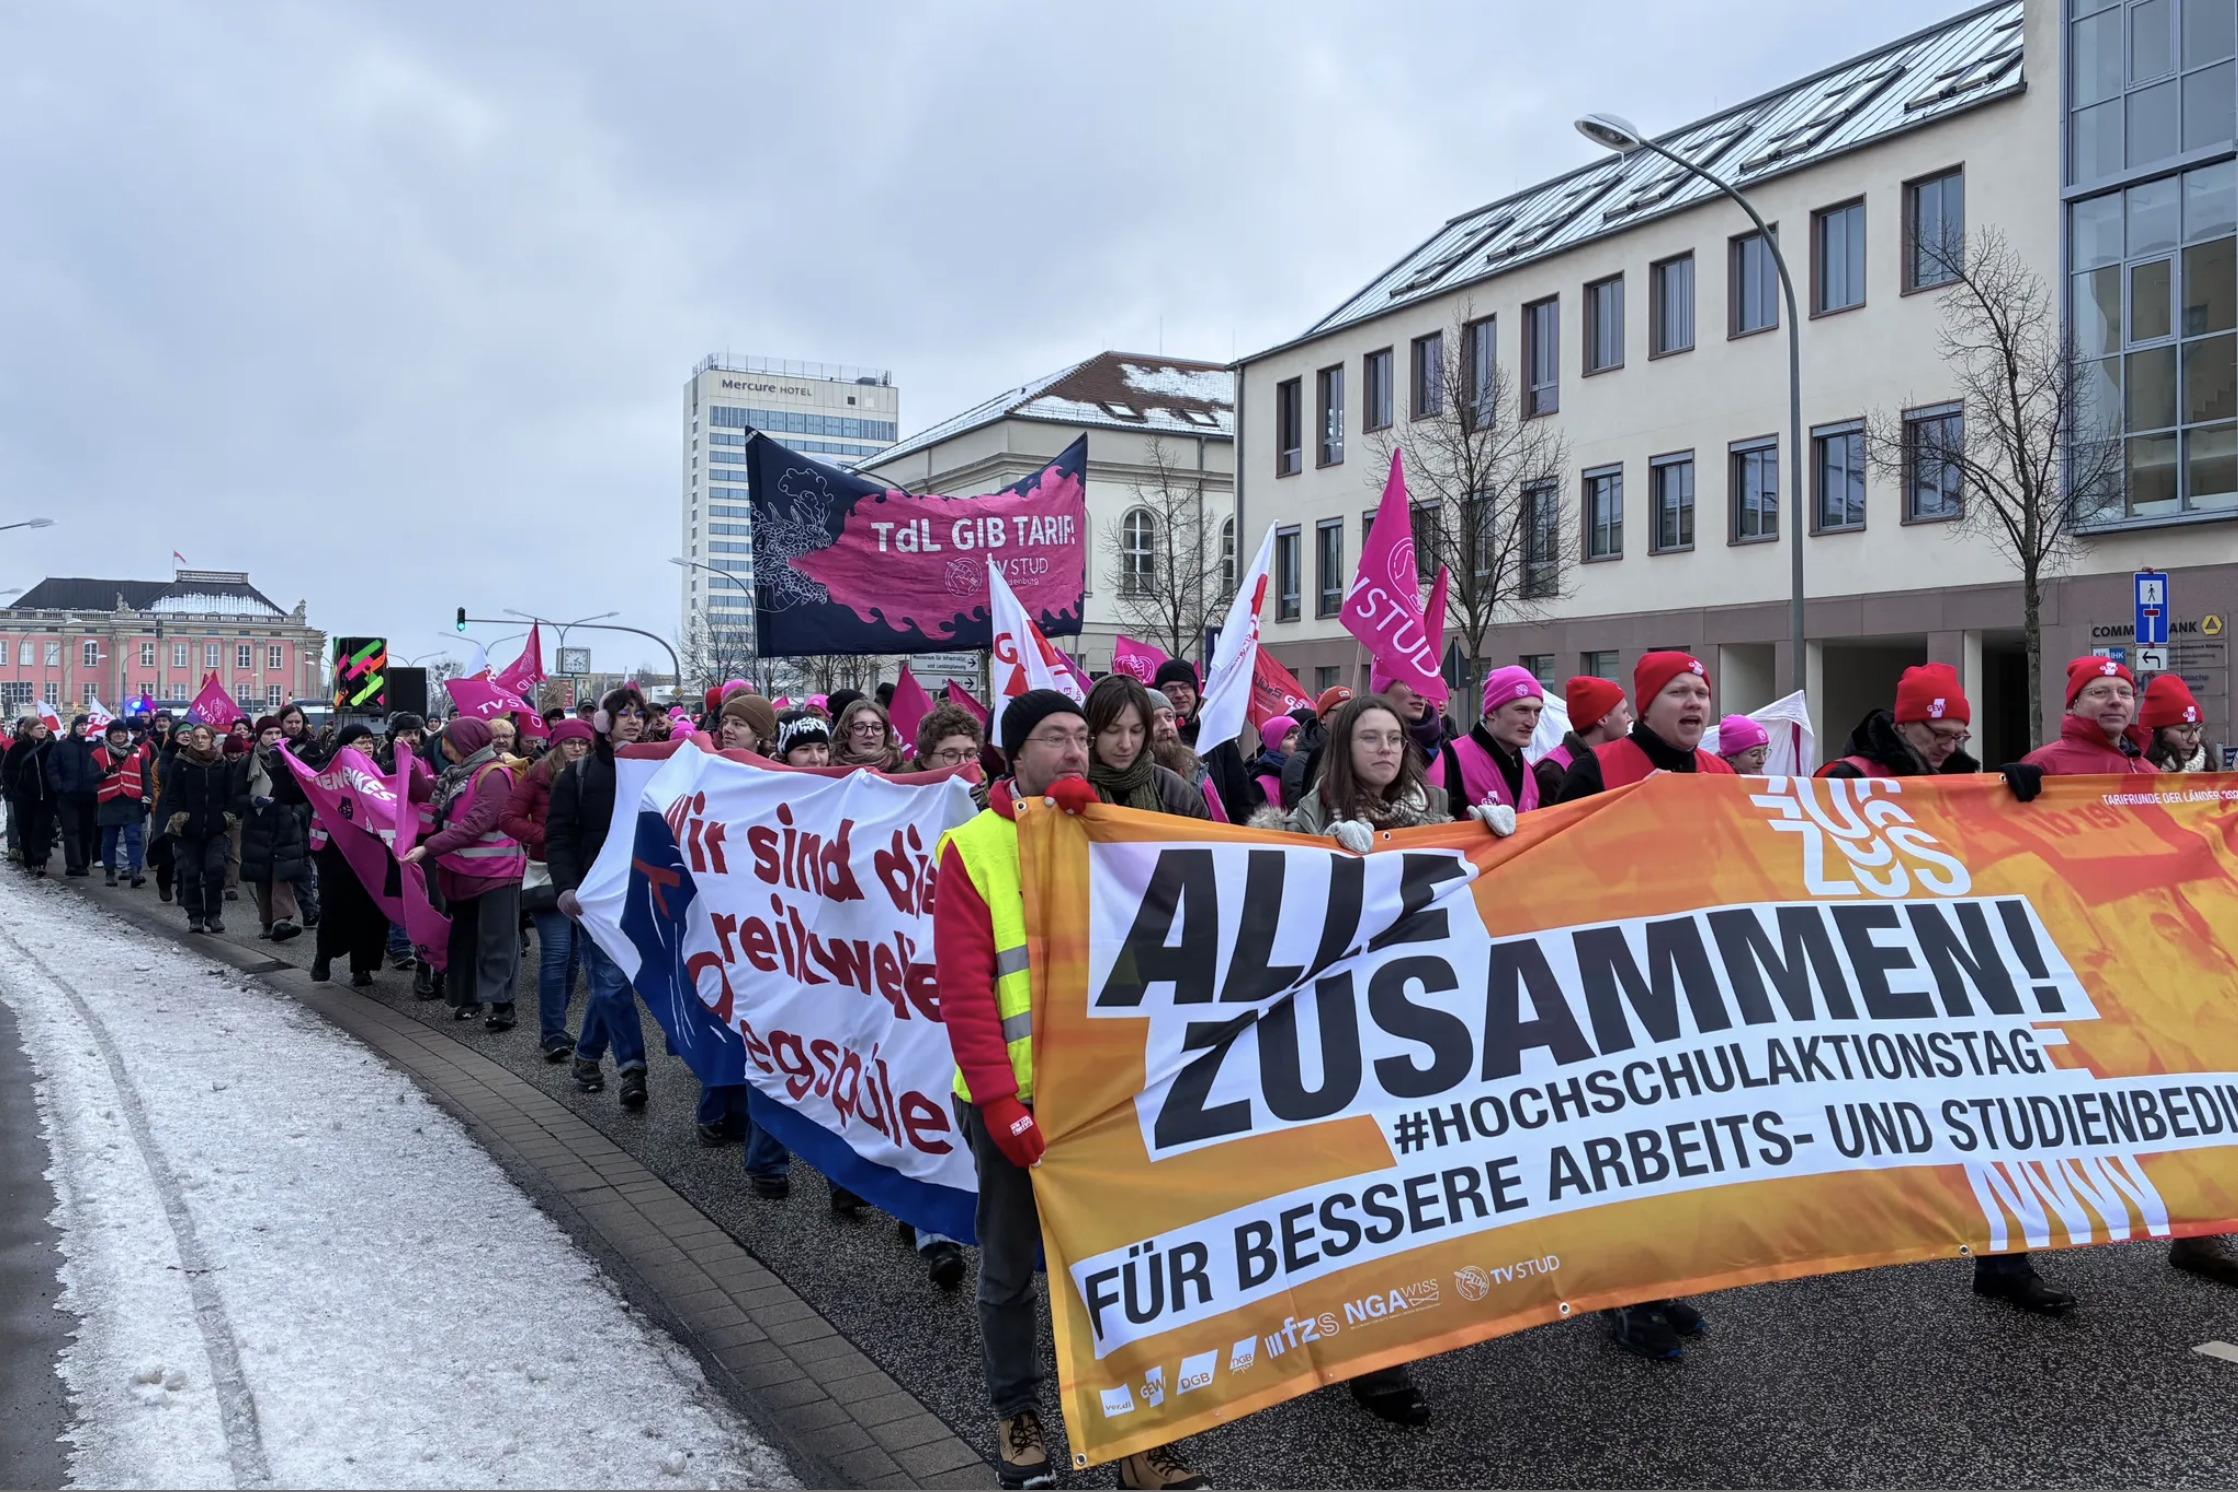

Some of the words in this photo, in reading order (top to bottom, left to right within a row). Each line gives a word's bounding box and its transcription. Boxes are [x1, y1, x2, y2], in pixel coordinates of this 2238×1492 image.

[722, 379, 776, 393] Mercure
[780, 386, 812, 396] HOTEL
[871, 518, 942, 553] TdL
[952, 516, 1006, 550] GIB
[1010, 557, 1049, 576] STUD
[1356, 588, 1440, 678] STUD
[2092, 621, 2198, 638] COMMANK
[2110, 651, 2124, 659] IHK
[477, 699, 503, 715] TV
[2102, 793, 2162, 806] TARIFRUNDE
[2162, 792, 2183, 804] DER
[2183, 789, 2220, 802] LÄNDER
[747, 802, 865, 902] sind
[1095, 848, 1467, 1007] ALLE
[1154, 900, 2067, 1150] ZUSAMMEN!
[1393, 1028, 2045, 1155] #HOCHSCHULAKTIONSTAG
[1084, 1239, 1214, 1342] FÜR
[1234, 1156, 1529, 1291] BESSERE
[1547, 1111, 1814, 1202] ARBEITS-
[1826, 1101, 1934, 1158] UND
[1140, 1376, 1167, 1399] GEW
[1181, 1372, 1211, 1390] DGB
[1231, 1353, 1253, 1368] DGB
[1281, 1312, 1340, 1349] fzs
[1490, 1265, 1514, 1285] TV
[1516, 1255, 1560, 1279] STUD
